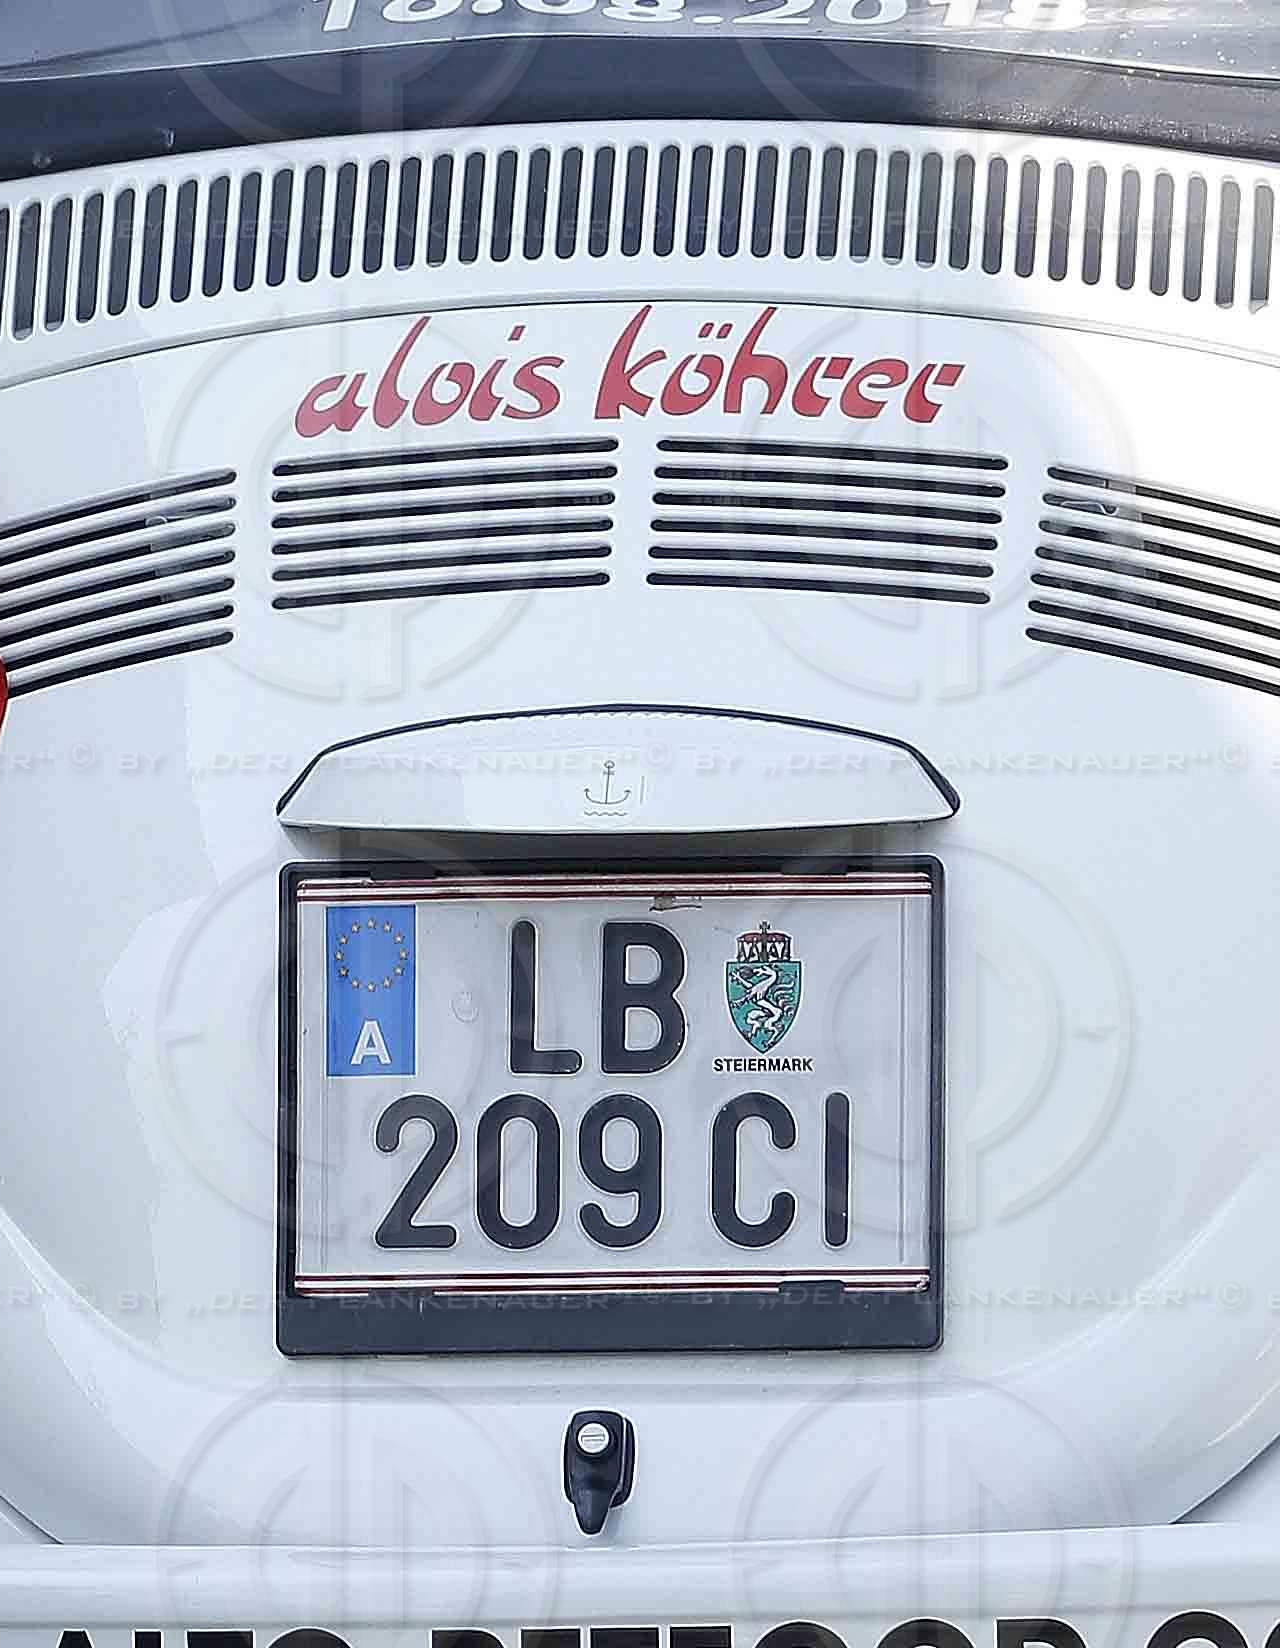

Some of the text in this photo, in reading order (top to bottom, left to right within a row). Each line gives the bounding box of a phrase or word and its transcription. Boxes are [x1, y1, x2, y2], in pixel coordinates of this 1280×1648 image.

[294, 314, 566, 439] alois
[349, 1019, 394, 1067] A
[508, 918, 688, 1077] LB
[711, 1055, 816, 1074] STEIERMARK
[372, 1092, 852, 1251] 209 CI
